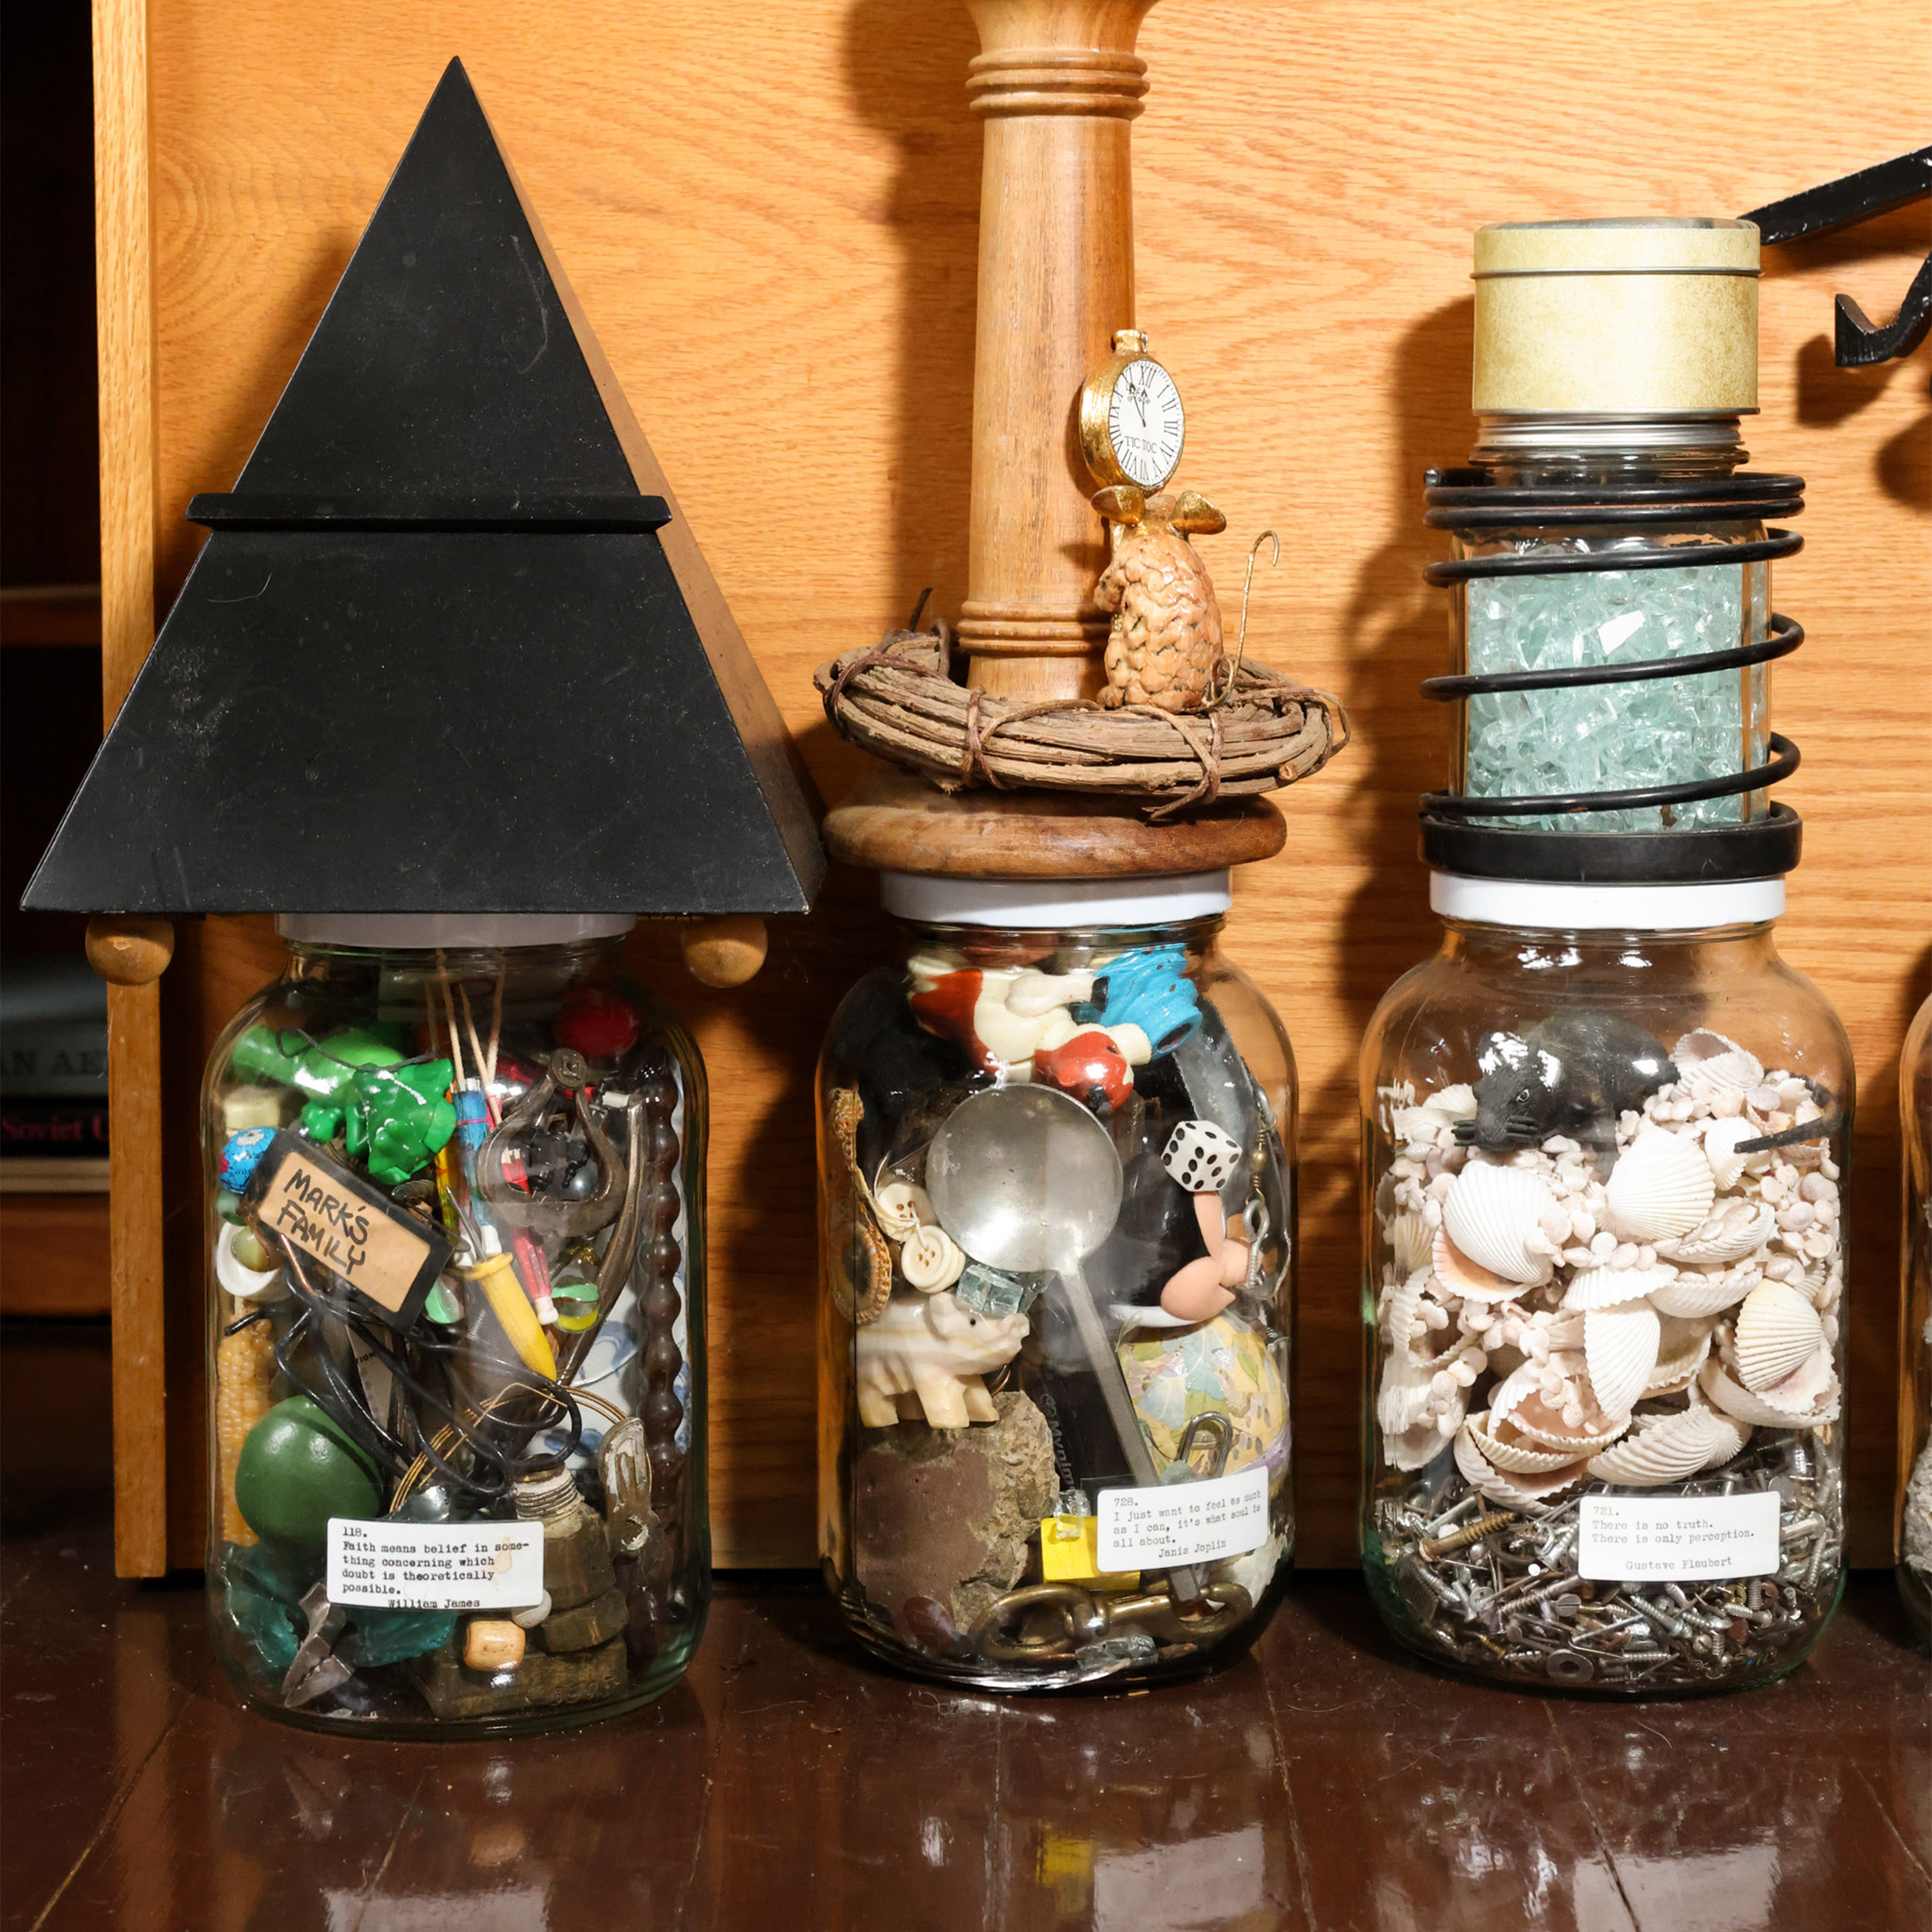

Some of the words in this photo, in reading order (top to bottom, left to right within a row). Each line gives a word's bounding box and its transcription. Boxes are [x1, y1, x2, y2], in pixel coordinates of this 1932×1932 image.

[1139, 366, 1157, 388] XII
[1164, 421, 1178, 436] III
[1124, 436, 1140, 449] TIC
[1141, 439, 1157, 454] TOC
[2, 1115, 83, 1141] Soviet
[284, 1168, 369, 1246] MARK'S
[277, 1199, 366, 1275] FAMILY
[1048, 1419, 1075, 1490] Mynim
[1114, 1498, 1138, 1507] 728.
[1128, 1509, 1152, 1522] just
[1158, 1507, 1182, 1517] want
[1189, 1504, 1200, 1513] to
[1206, 1499, 1226, 1511] feel
[1243, 1491, 1261, 1502] much
[1134, 1524, 1140, 1532] I
[1147, 1523, 1170, 1532] can,
[1178, 1518, 1200, 1529] it's
[1206, 1513, 1226, 1525] what
[1230, 1509, 1249, 1519] soul
[1252, 1504, 1260, 1513] is
[1594, 1506, 1620, 1516] 721.
[1592, 1520, 1628, 1530] There
[1676, 1519, 1713, 1529] truth.
[342, 1527, 367, 1538] 118.
[1591, 1533, 1628, 1543] There
[1635, 1535, 1648, 1543] is
[1655, 1533, 1682, 1544] only
[1689, 1529, 1754, 1544] perception.
[342, 1541, 376, 1553] Faith
[381, 1545, 417, 1553] means
[424, 1544, 468, 1553] belief
[474, 1543, 488, 1553] in
[495, 1542, 529, 1552] some-
[1113, 1539, 1133, 1548] all
[1139, 1535, 1175, 1546] about.
[1158, 1547, 1189, 1558] Janis
[1194, 1539, 1226, 1553] Joplin
[342, 1556, 376, 1567] thing
[382, 1559, 452, 1568] concerning
[459, 1556, 495, 1566] which
[1625, 1560, 1675, 1570] Gustave
[1681, 1557, 1732, 1570] Flaubert
[342, 1569, 375, 1580] doubt
[383, 1570, 395, 1580] is
[403, 1570, 495, 1581] theoretically
[342, 1583, 401, 1594] possible.
[388, 1599, 437, 1608] William
[444, 1599, 481, 1608] James
